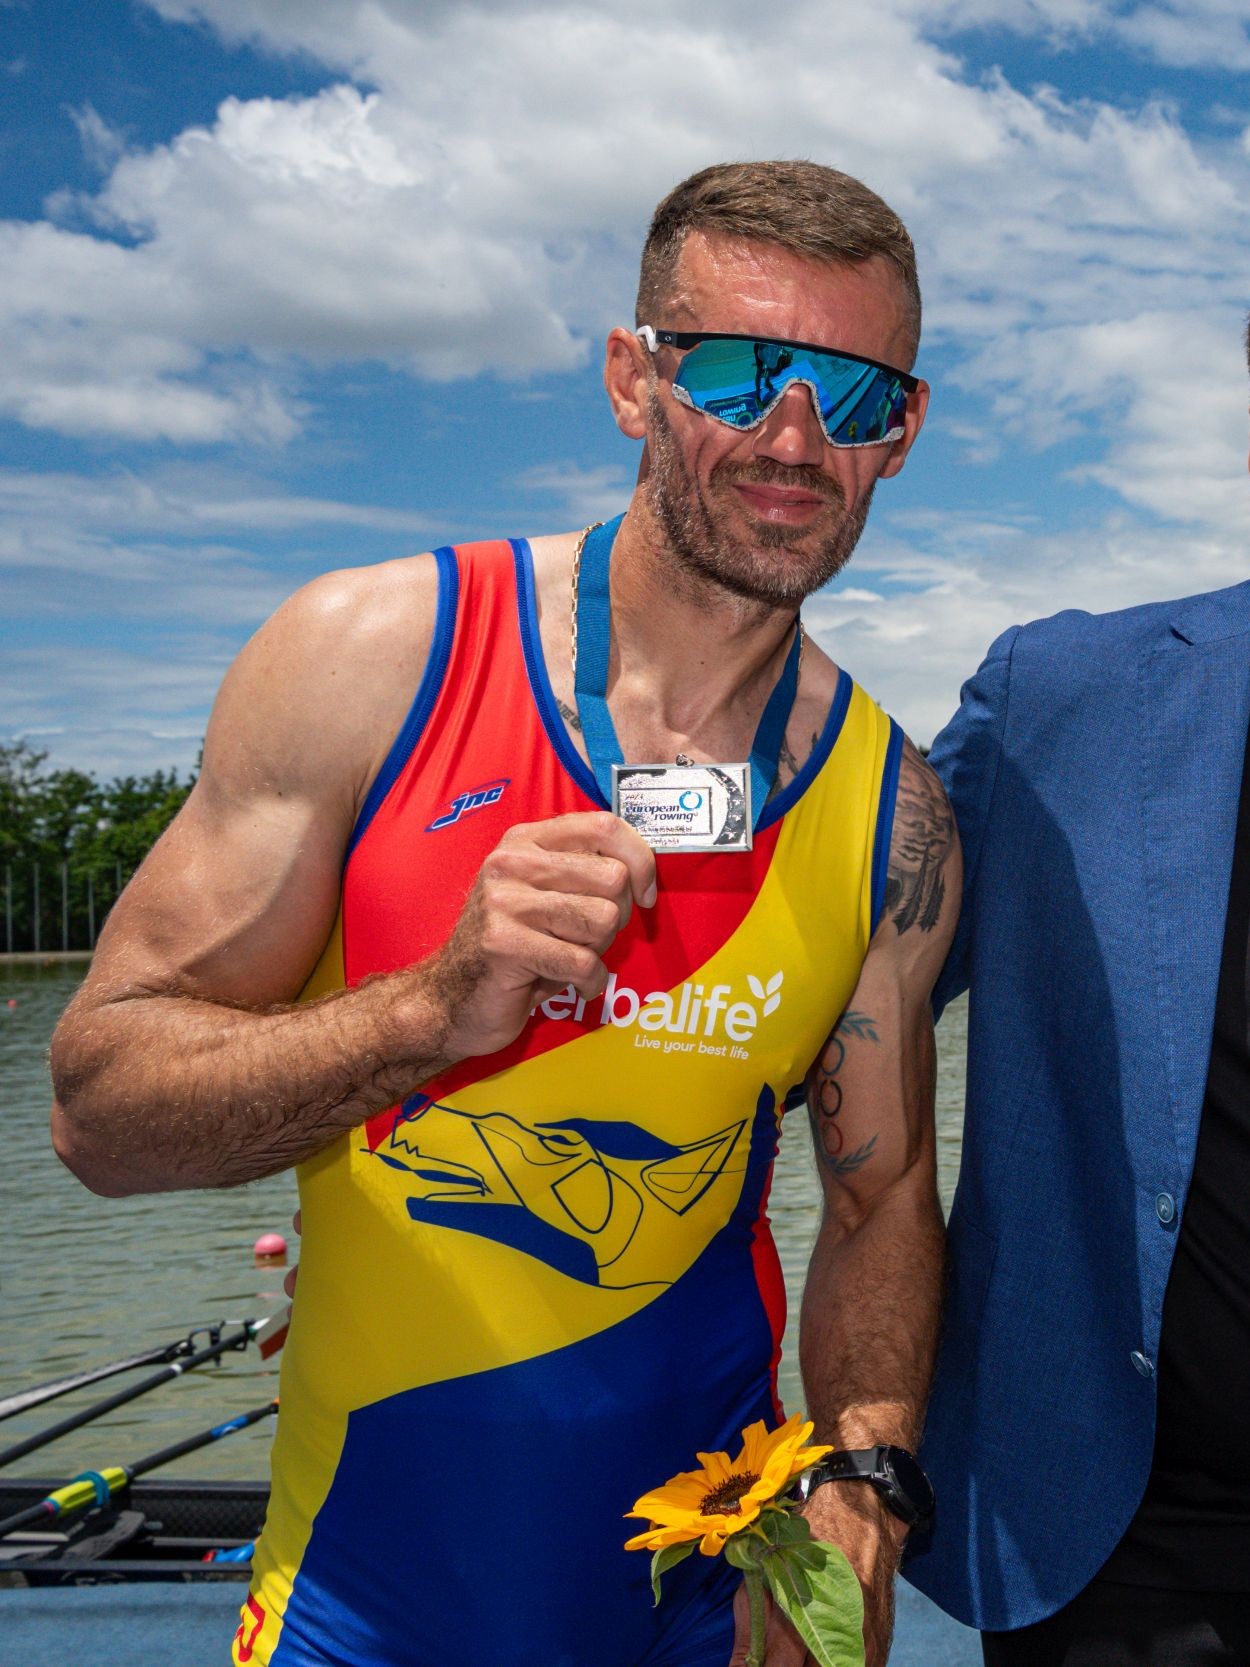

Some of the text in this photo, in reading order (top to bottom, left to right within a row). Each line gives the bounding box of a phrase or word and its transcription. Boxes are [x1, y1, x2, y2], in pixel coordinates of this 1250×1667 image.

[625, 805, 680, 814] european
[653, 813, 693, 822] rowing
[529, 972, 758, 1042] ebalife
[634, 1034, 750, 1060] Live your best life
